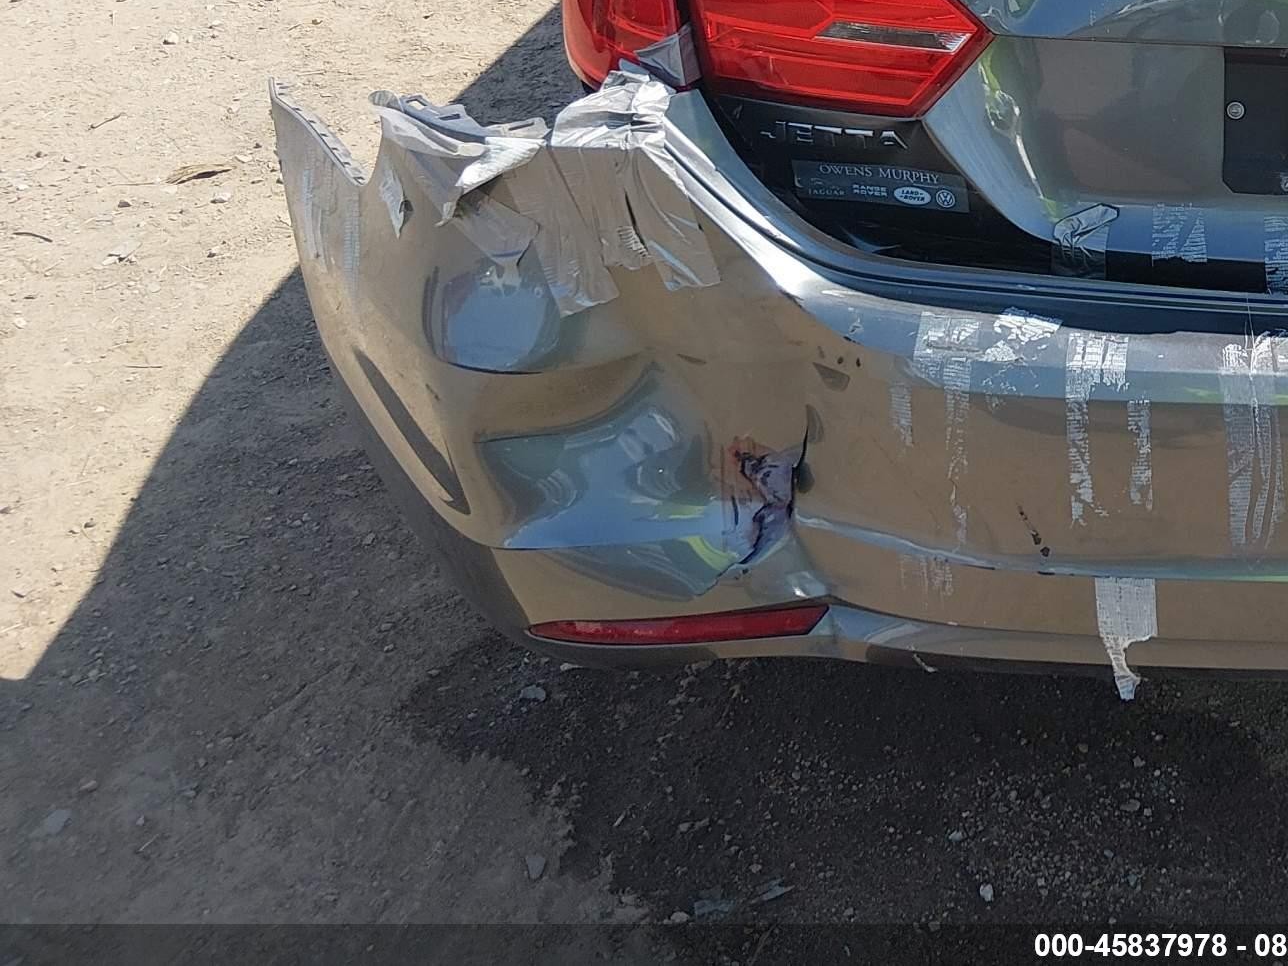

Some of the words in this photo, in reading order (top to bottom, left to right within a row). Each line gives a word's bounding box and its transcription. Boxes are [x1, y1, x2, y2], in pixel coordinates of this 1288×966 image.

[760, 120, 909, 151] JETTA
[819, 165, 873, 178] OWENS
[879, 168, 940, 184] MURPHY
[808, 188, 845, 196] JAGUAR
[852, 184, 887, 192] RANGE
[852, 189, 888, 197] ROVER
